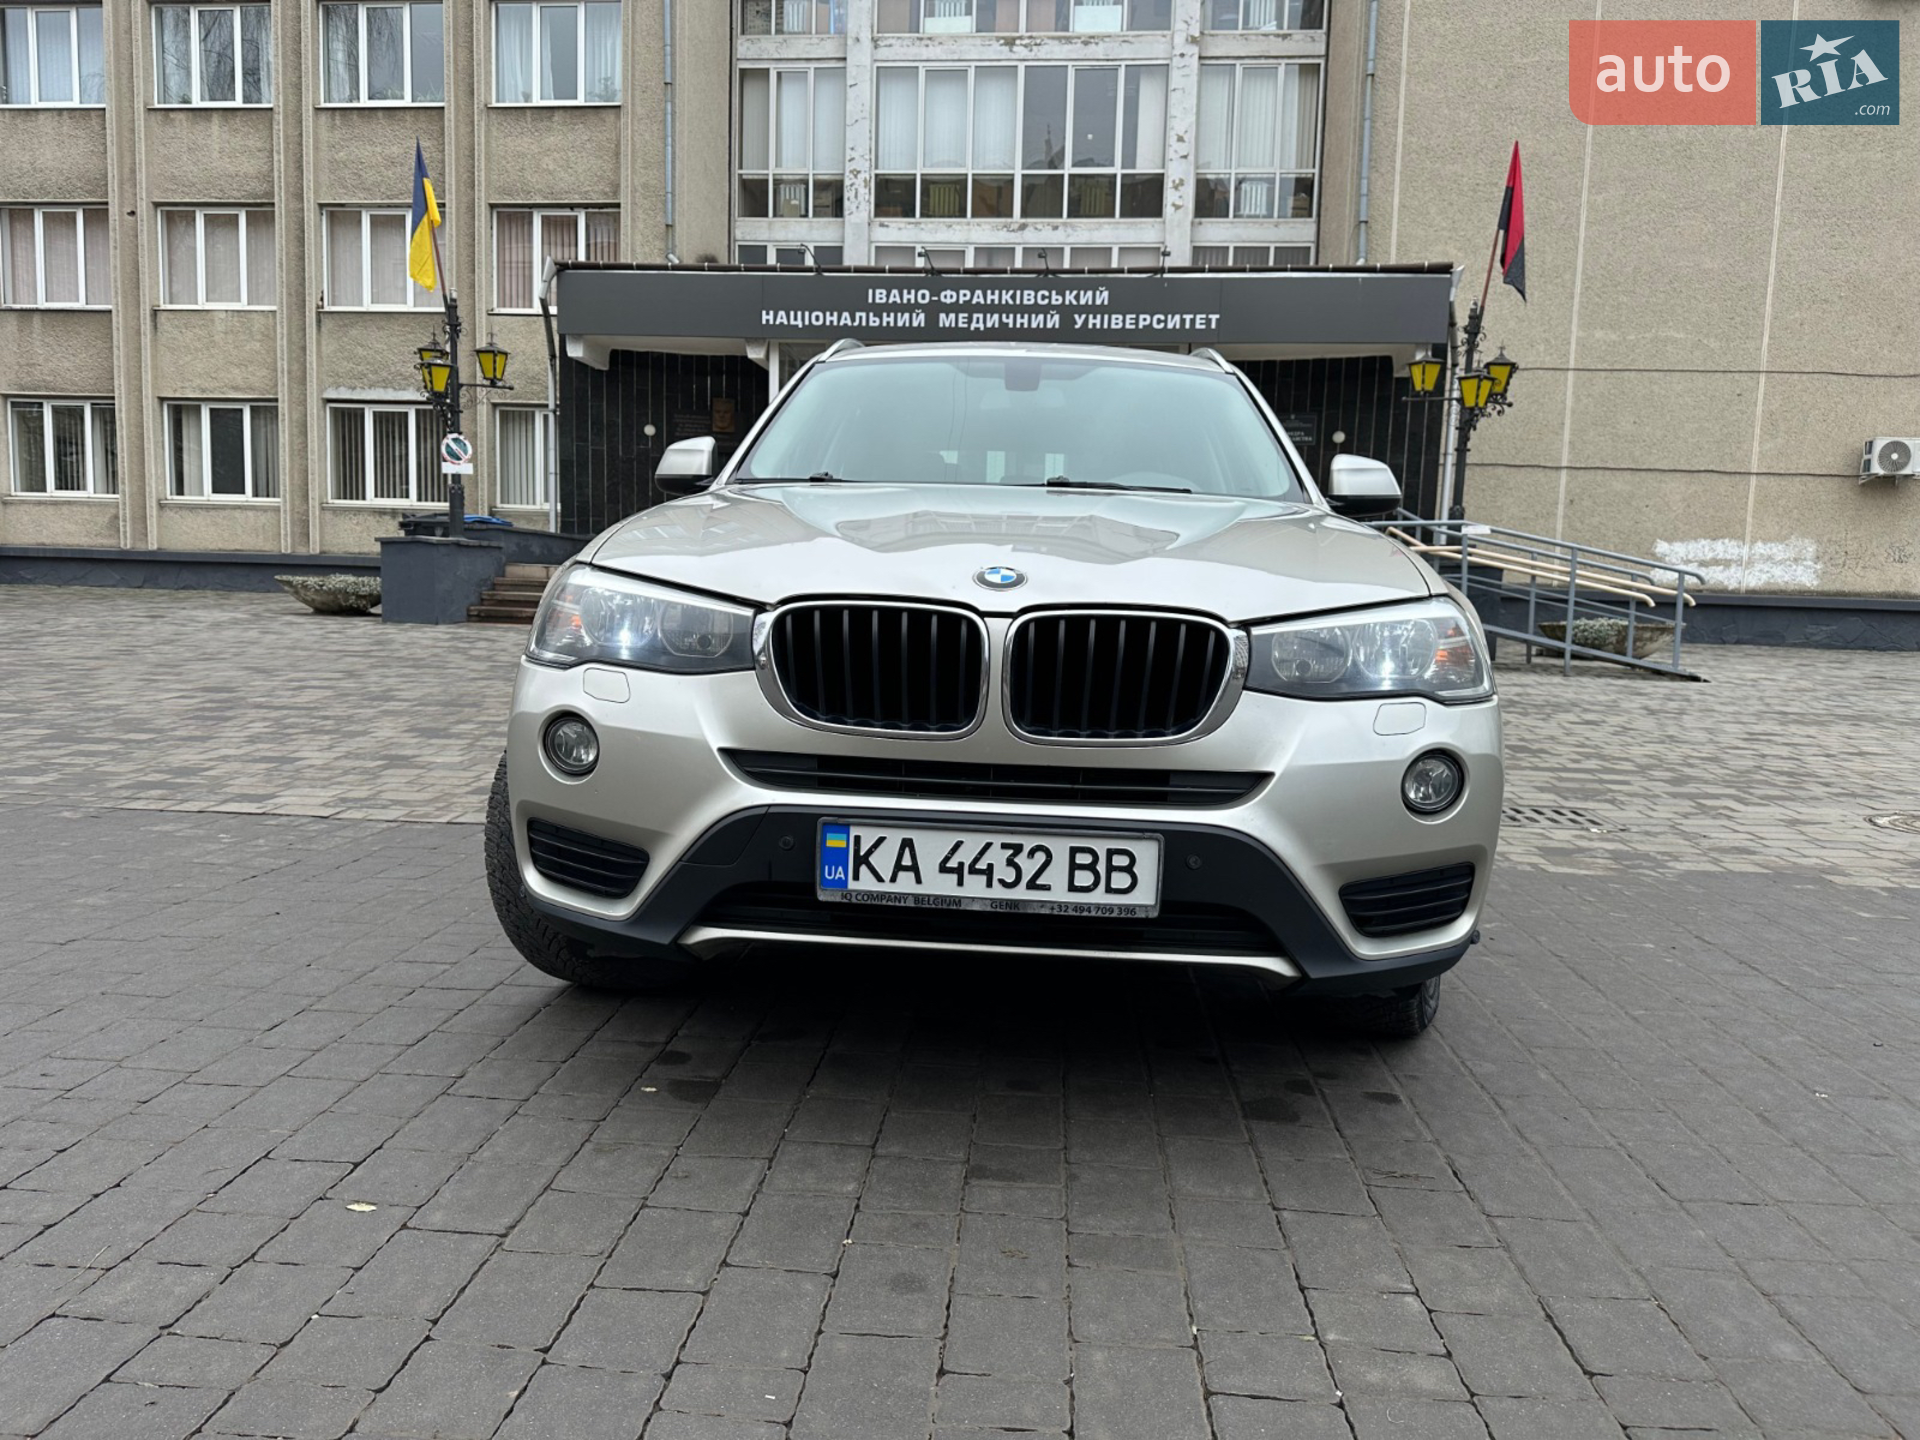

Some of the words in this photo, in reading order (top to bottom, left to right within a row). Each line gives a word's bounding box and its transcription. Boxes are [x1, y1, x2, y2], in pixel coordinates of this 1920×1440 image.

[867, 287, 1110, 308] ІВАНО-ФРАНКІВСЬКИЙ
[761, 310, 926, 330] НАЦІОНАЛЬНИЙ
[938, 311, 1061, 332] МЕДИЧНИЙ
[1073, 313, 1221, 331] УНІВЕРСИТЕТ
[824, 865, 846, 881] UA
[851, 834, 923, 885] KA
[938, 839, 1054, 891] 4432
[1067, 845, 1140, 896] BB
[855, 894, 909, 905] COMPANY
[913, 898, 963, 908] BELGIUM
[990, 901, 1020, 911] GENK
[1050, 904, 1069, 914] +32
[1071, 905, 1092, 915] 494
[1095, 906, 1115, 916] 709
[1116, 906, 1137, 917] 396
